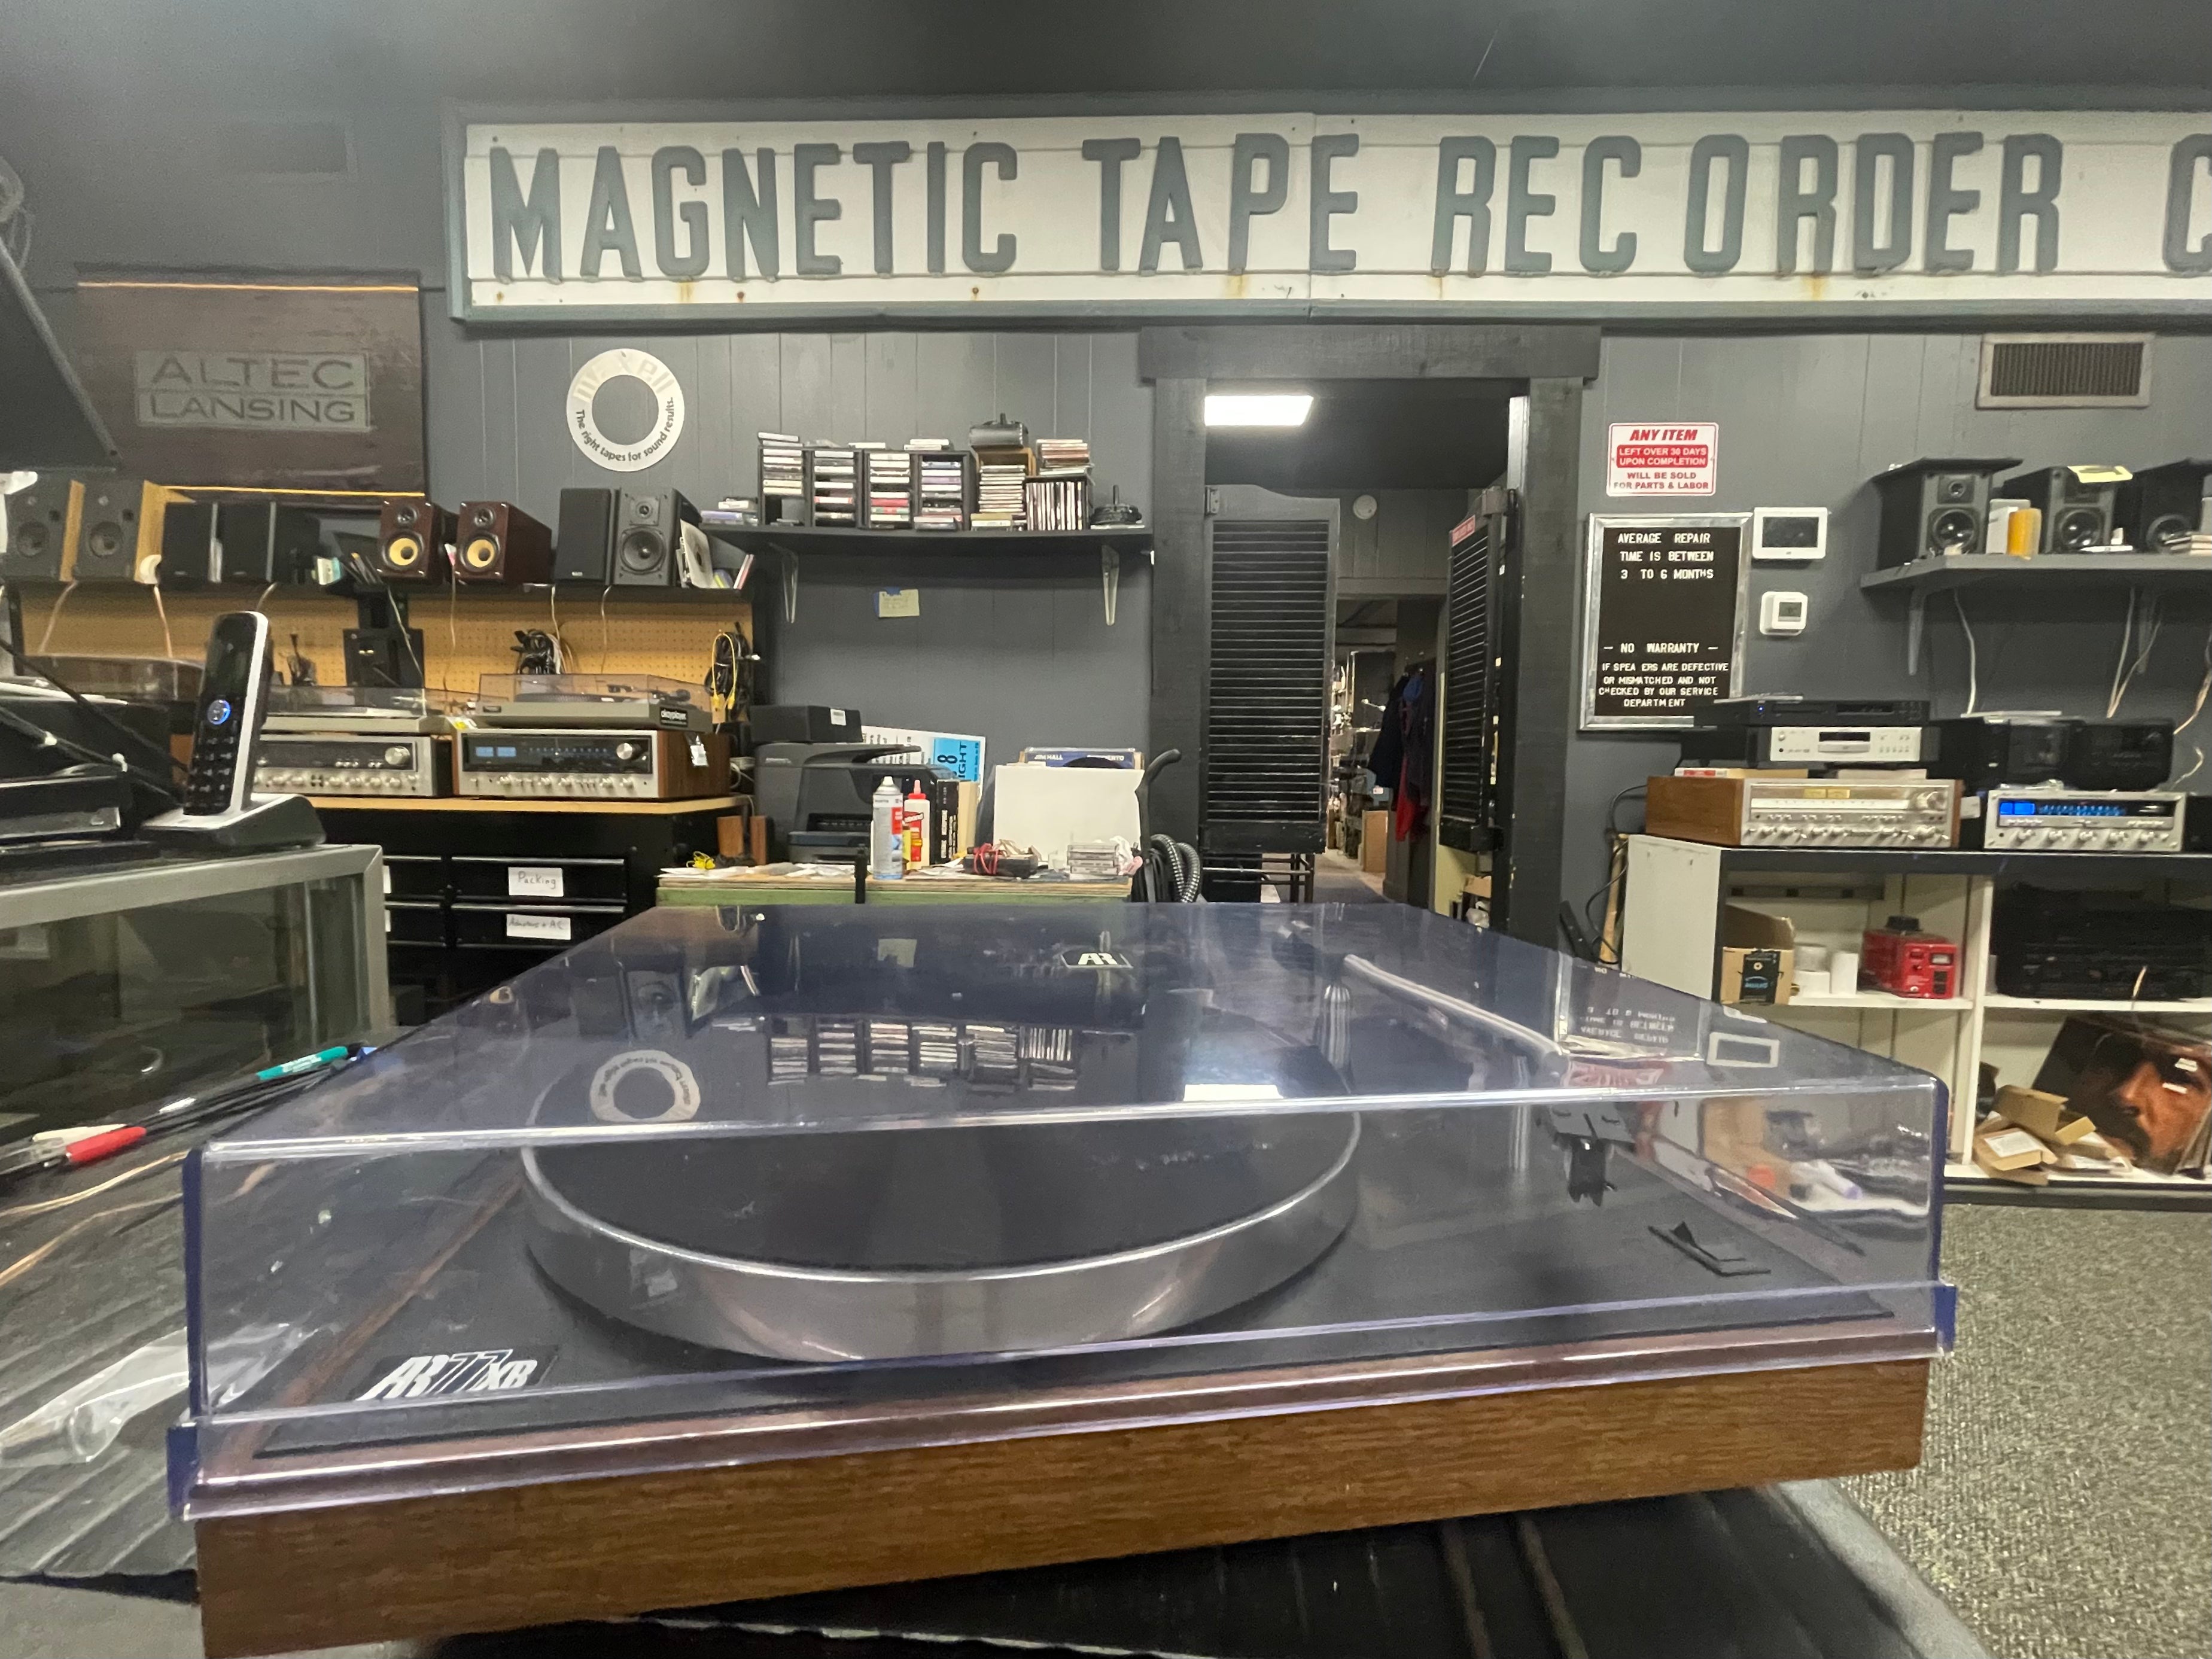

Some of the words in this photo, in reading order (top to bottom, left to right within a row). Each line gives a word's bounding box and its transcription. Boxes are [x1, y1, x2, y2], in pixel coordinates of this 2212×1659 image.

[489, 141, 1017, 283] MAGNETIC
[1082, 133, 1359, 276] TAPE
[151, 357, 354, 390] ALTEC
[150, 394, 355, 423] LANSING
[576, 409, 585, 429] The
[582, 432, 601, 451] right
[600, 447, 625, 461] tapes
[628, 452, 641, 461] for
[643, 431, 667, 456] sound
[1629, 429, 1660, 441] ANY
[1662, 429, 1698, 441] ITEM
[1619, 448, 1641, 456] LEFT
[1644, 448, 1668, 456] OVER
[1683, 448, 1706, 456] DAYS
[1619, 457, 1645, 465] UPON
[1618, 532, 1662, 544] AVERAGE
[1674, 532, 1711, 543] REPAIR
[1620, 550, 1643, 562] TIME
[1650, 550, 1661, 561] IS
[1668, 550, 1714, 561] BETWEEN
[1620, 569, 1629, 580] 3
[1641, 569, 1654, 579] TO
[1660, 569, 1668, 579] 6
[1674, 569, 1714, 580] MONTHS
[1620, 643, 1635, 653] NO
[1647, 643, 1700, 653] WARRANTY
[1602, 663, 1611, 671] IF
[1661, 663, 1678, 671] ARE
[1681, 663, 1729, 671] DEFECTIVE
[1604, 676, 1615, 684] OR
[1618, 676, 1674, 684] MISMATCHED
[1678, 676, 1693, 684] AND
[1699, 676, 1716, 684] NOT
[1598, 687, 1639, 696] CHECKED
[1680, 687, 1718, 696] SERVICE
[1623, 698, 1685, 707] DEPARTMENT
[958, 741, 967, 778] IGHT
[518, 870, 556, 890] Packing
[1078, 952, 1118, 965] AR
